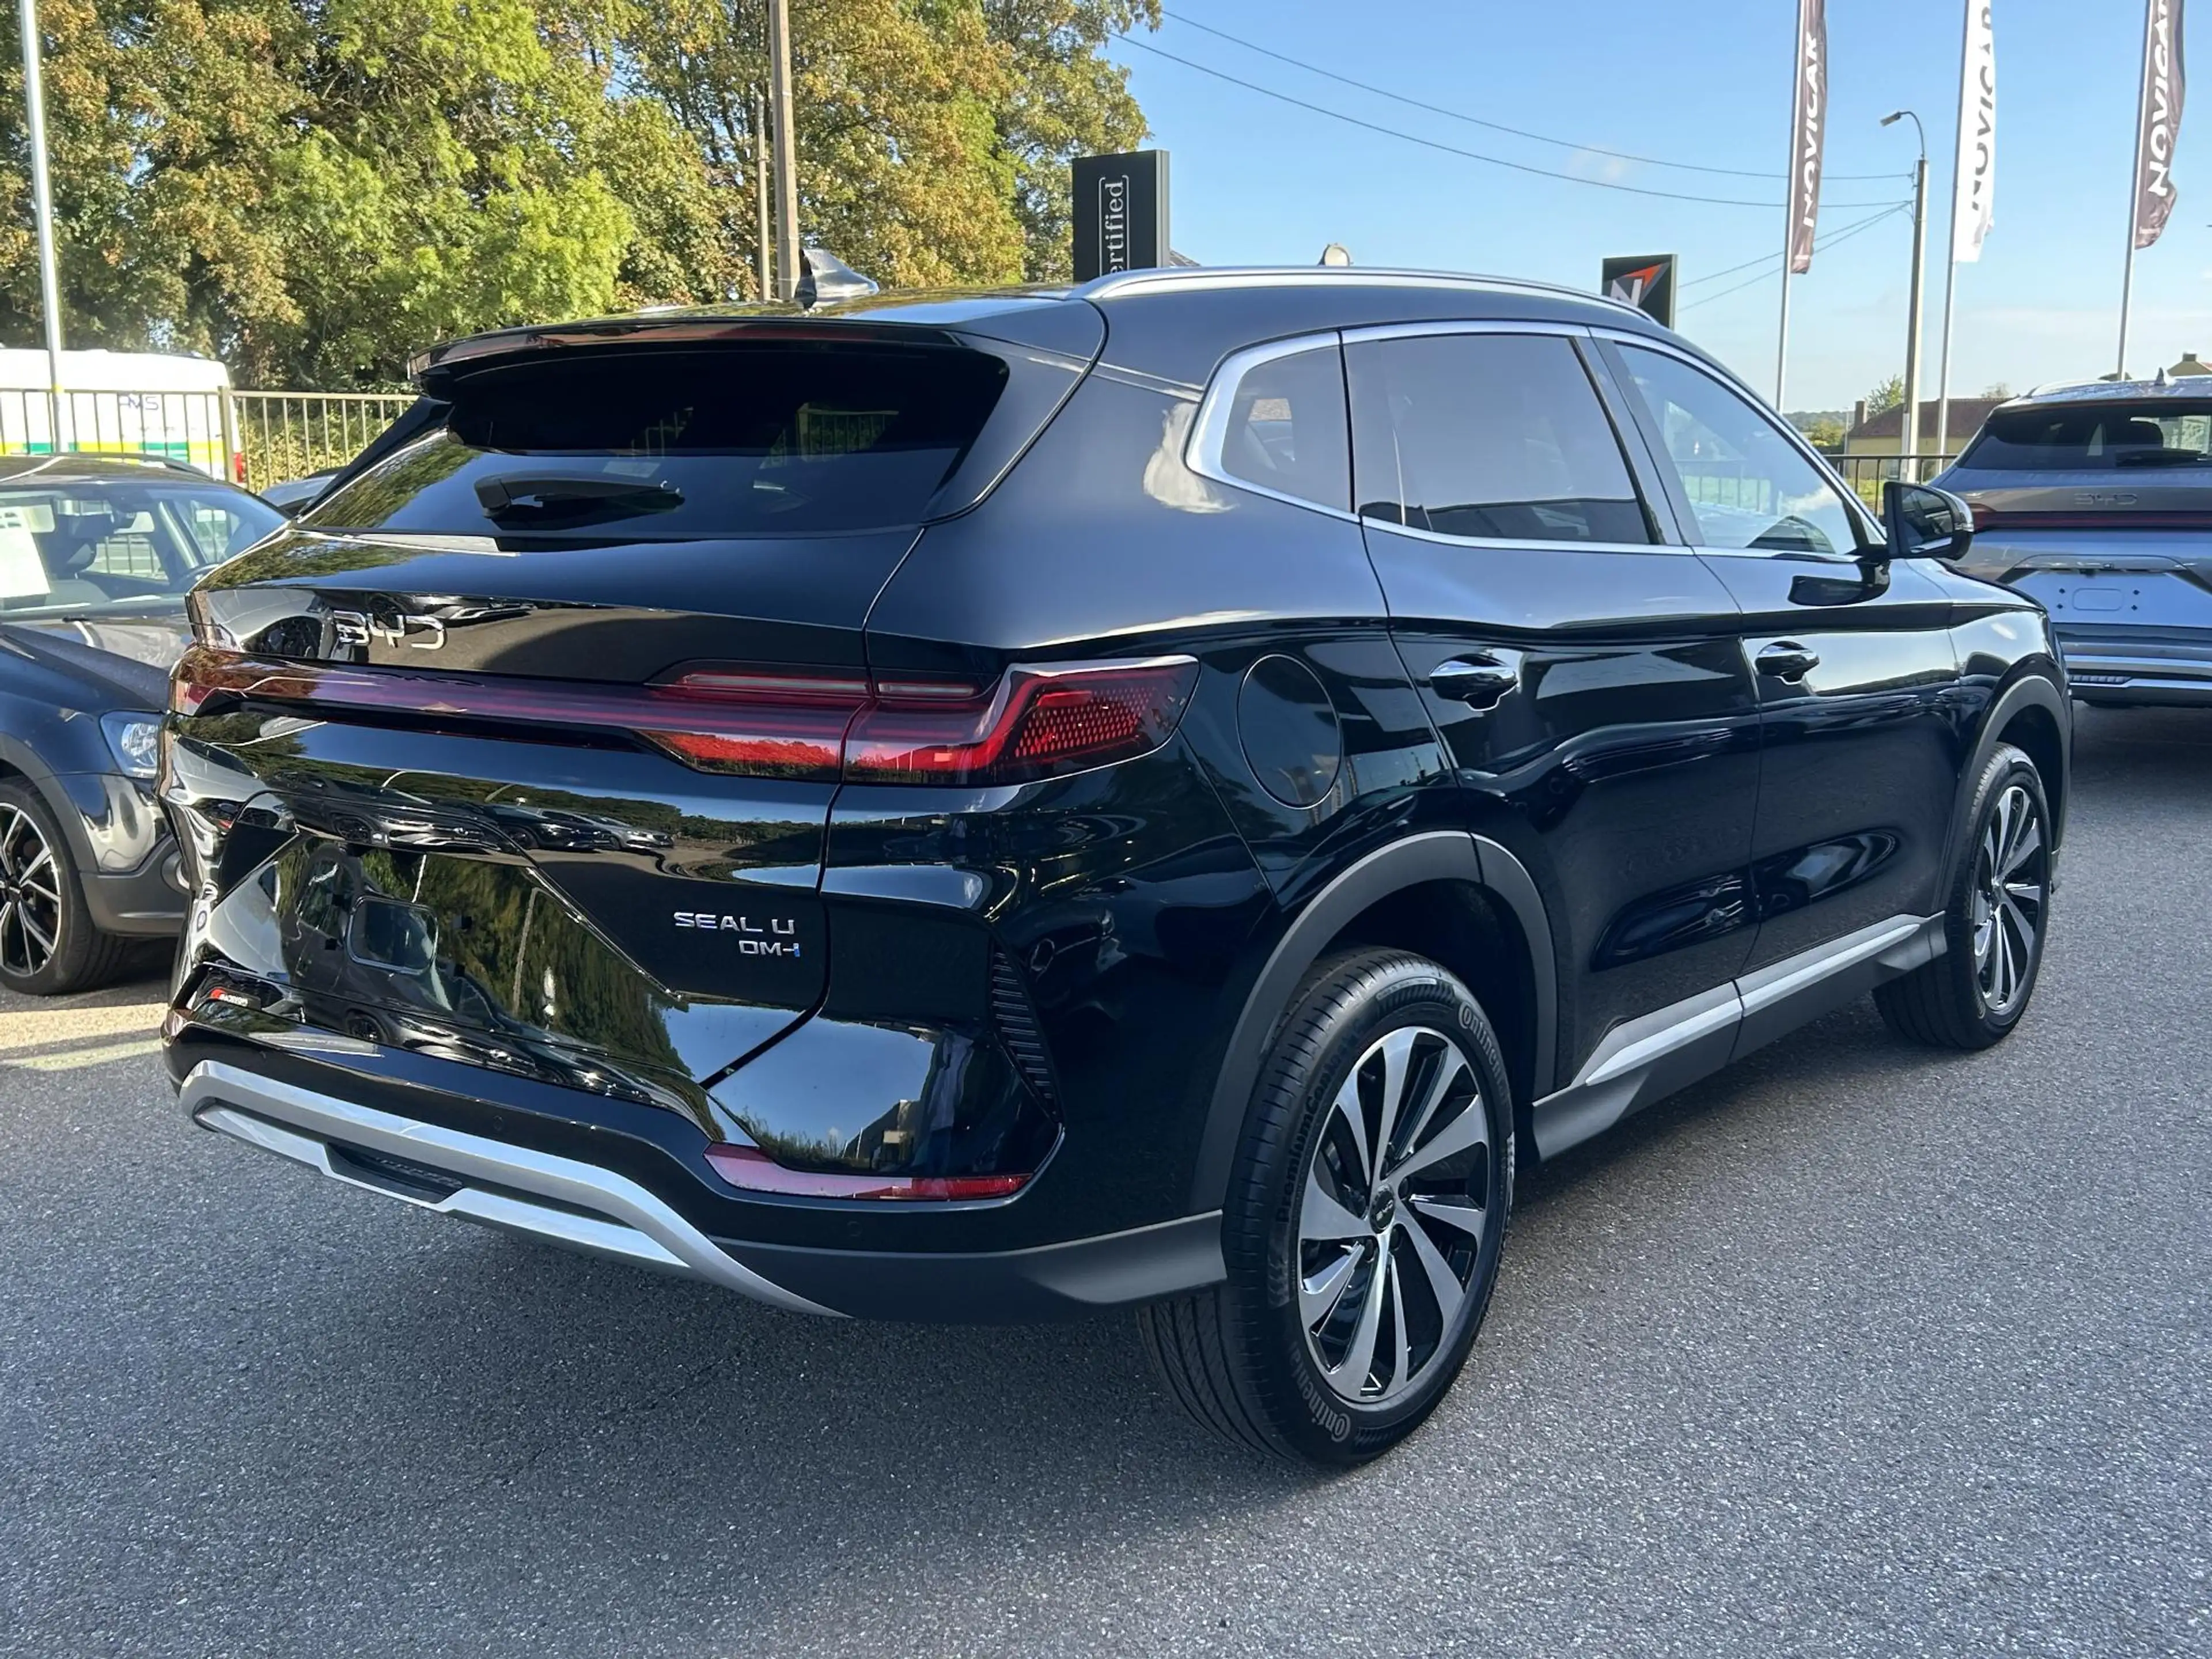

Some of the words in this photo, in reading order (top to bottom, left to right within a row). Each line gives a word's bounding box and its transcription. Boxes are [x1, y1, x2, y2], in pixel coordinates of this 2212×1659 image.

[1104, 181, 1124, 275] ertified
[2074, 493, 2138, 506] BYD
[332, 610, 447, 650] BYD
[673, 911, 763, 932] SEAL
[771, 919, 795, 935] U
